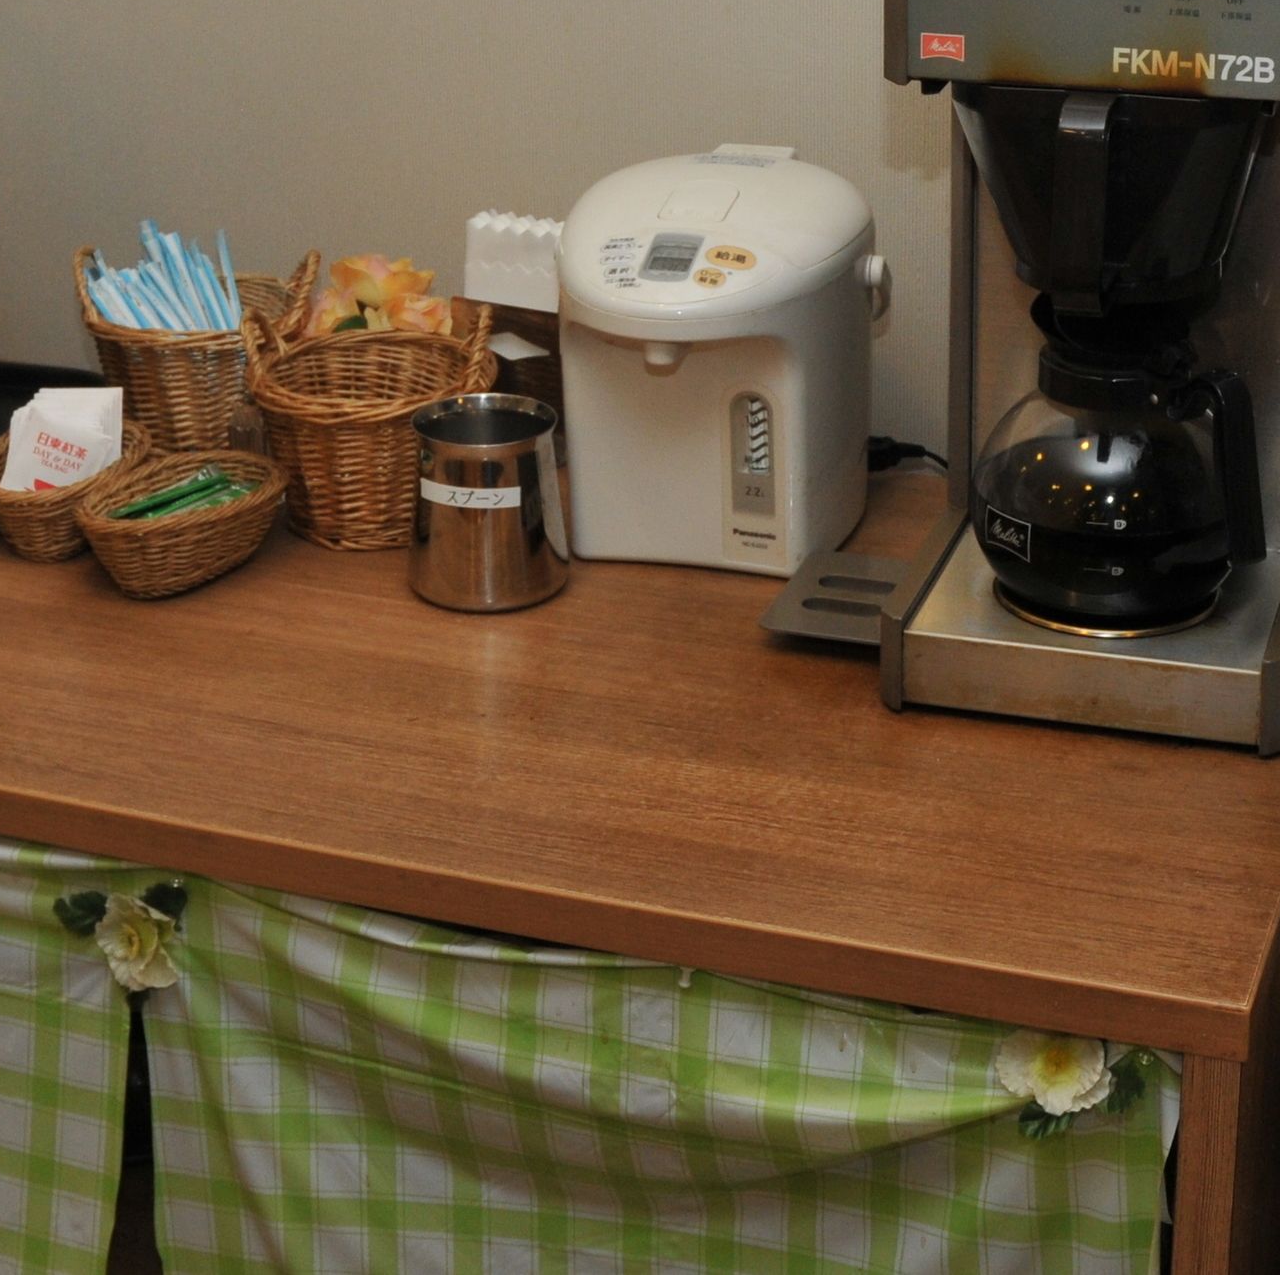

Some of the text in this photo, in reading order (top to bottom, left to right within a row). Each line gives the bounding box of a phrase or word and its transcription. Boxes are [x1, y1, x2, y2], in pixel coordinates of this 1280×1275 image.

[1112, 46, 1276, 84] FKM-N72B
[37, 431, 89, 461] 日東紅茶
[447, 490, 505, 506] スプーン
[732, 528, 777, 541] Panasonic
